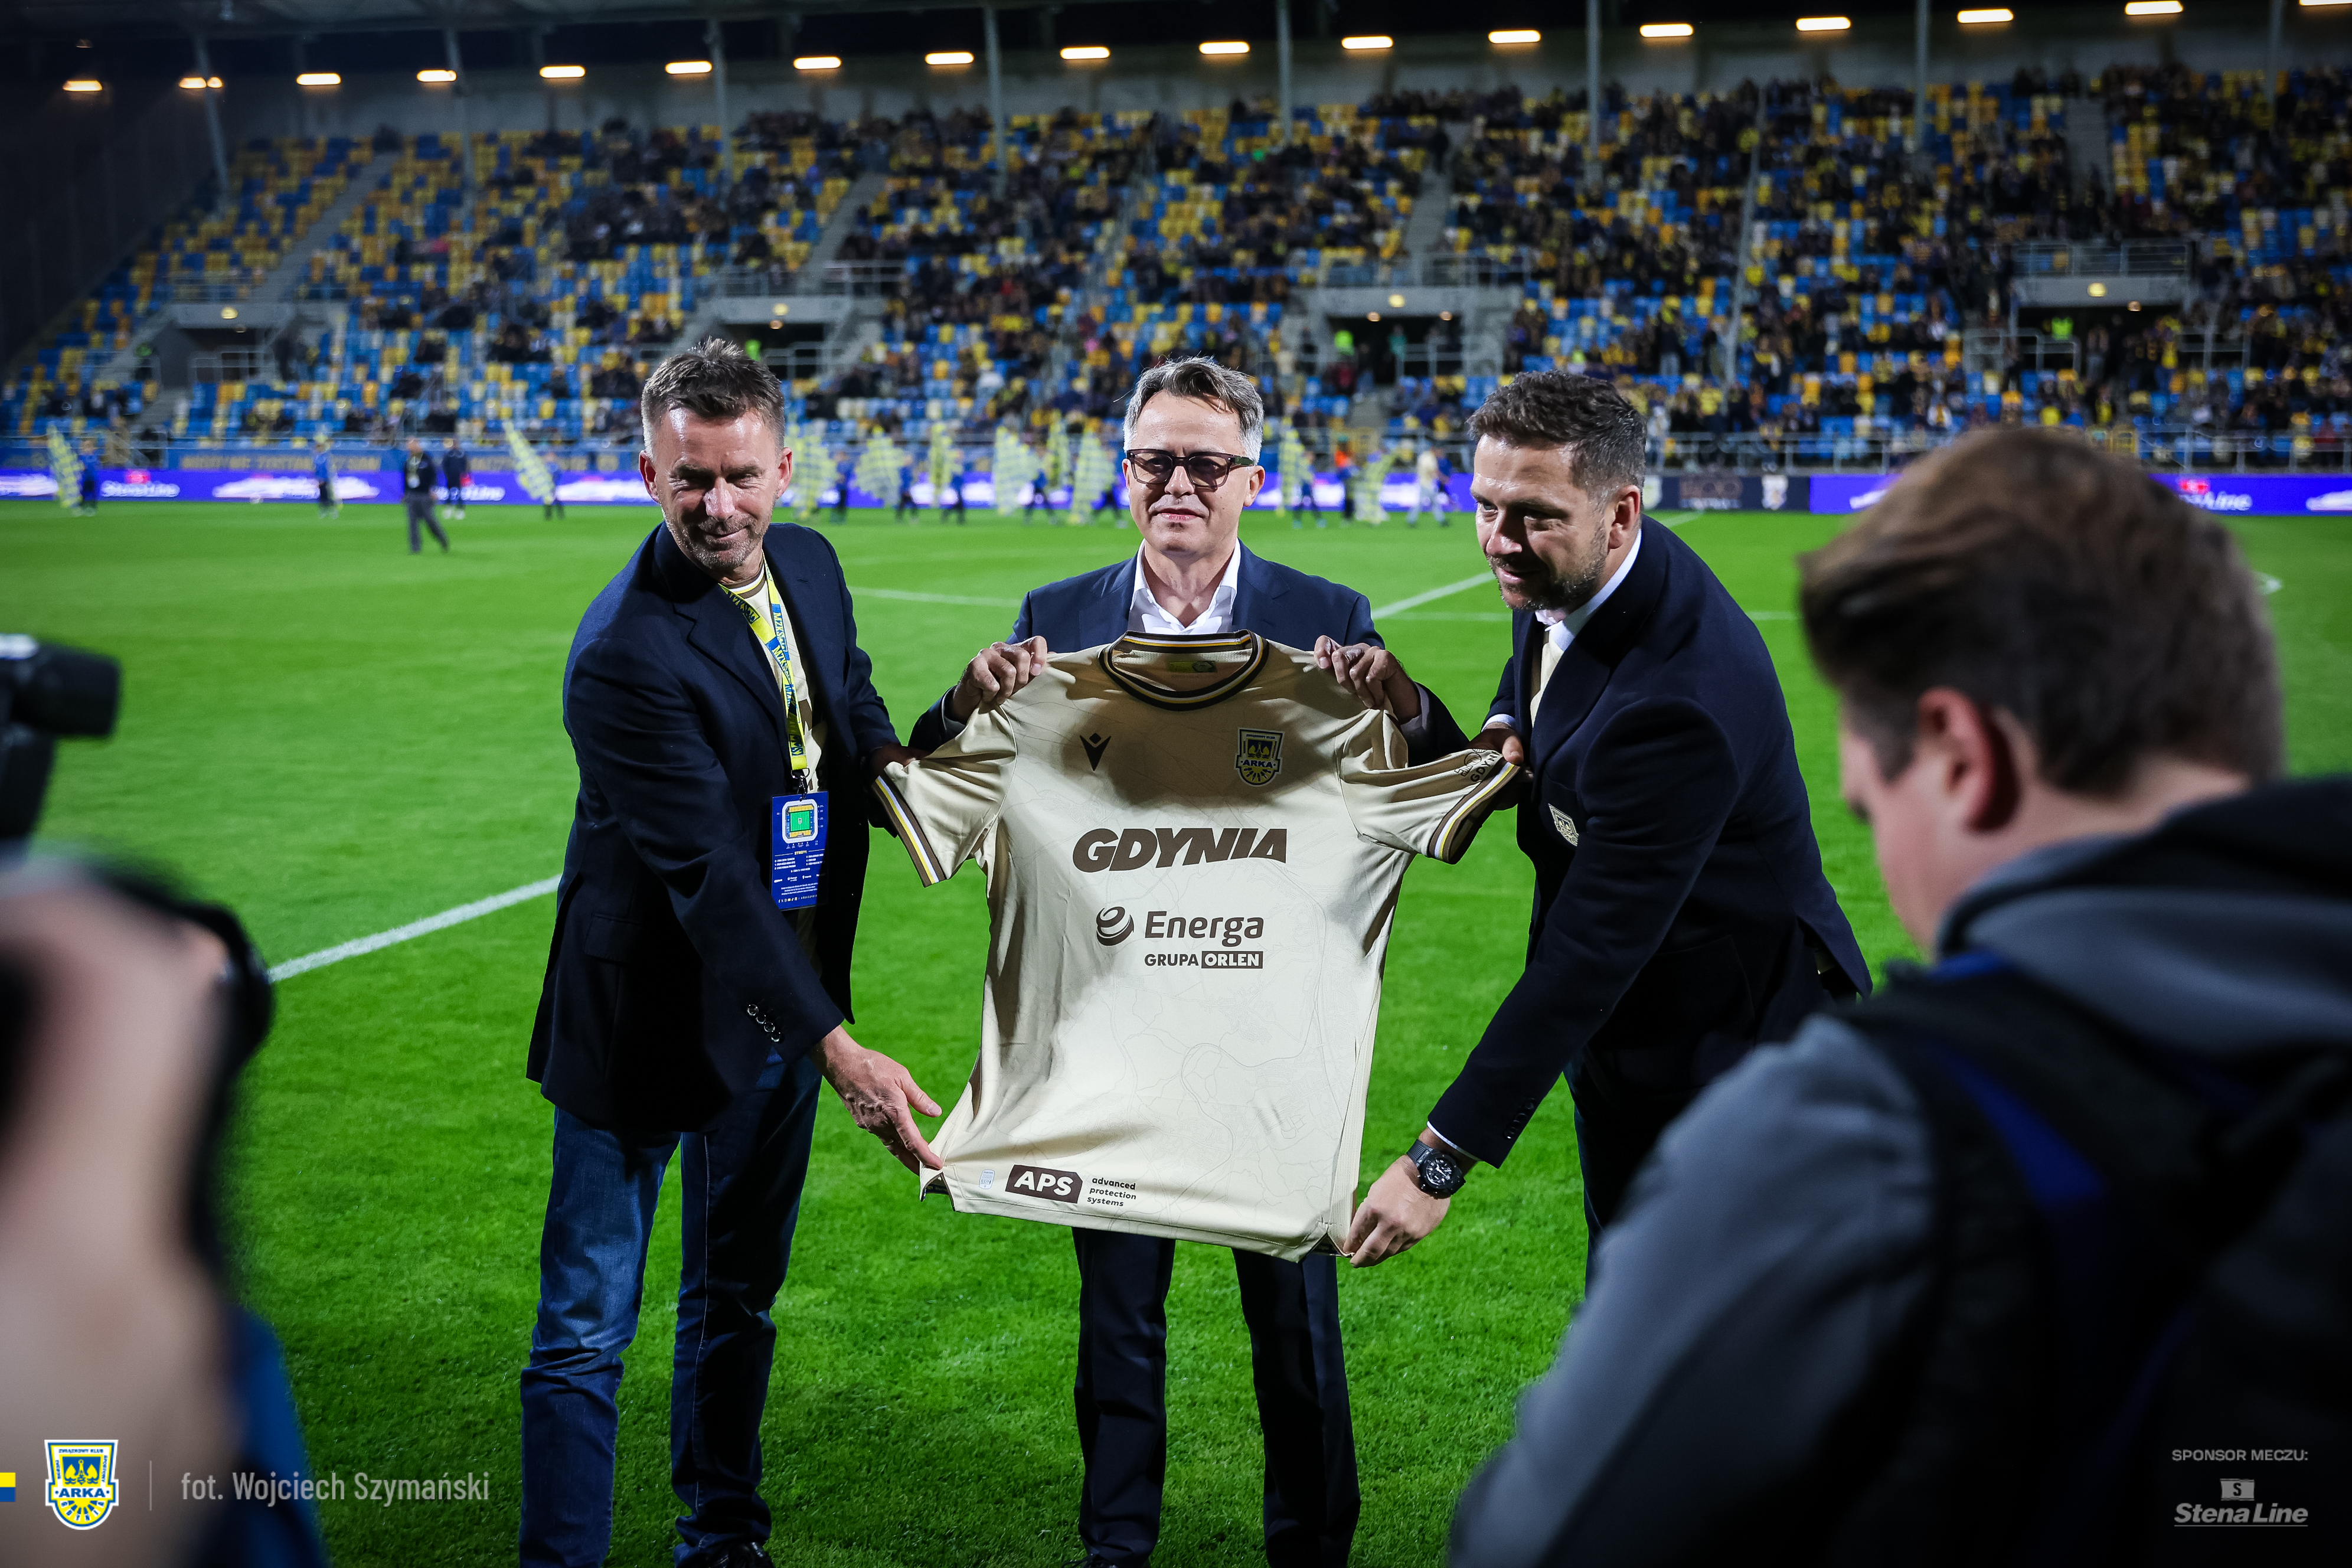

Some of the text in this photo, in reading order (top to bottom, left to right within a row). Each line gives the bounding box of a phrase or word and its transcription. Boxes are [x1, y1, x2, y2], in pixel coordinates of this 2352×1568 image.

[773, 612, 785, 637] MZKS
[1243, 759, 1273, 768] ARKA
[1471, 751, 1501, 782] GDYNI
[1072, 828, 1287, 873] GDYNIA
[1145, 911, 1264, 947] Energa
[1144, 953, 1259, 966] GRUPA ORLEN
[1014, 1171, 1073, 1196] APS
[1092, 1177, 1136, 1190] advanced
[1087, 1197, 1124, 1207] systems
[1089, 1187, 1136, 1200] protection
